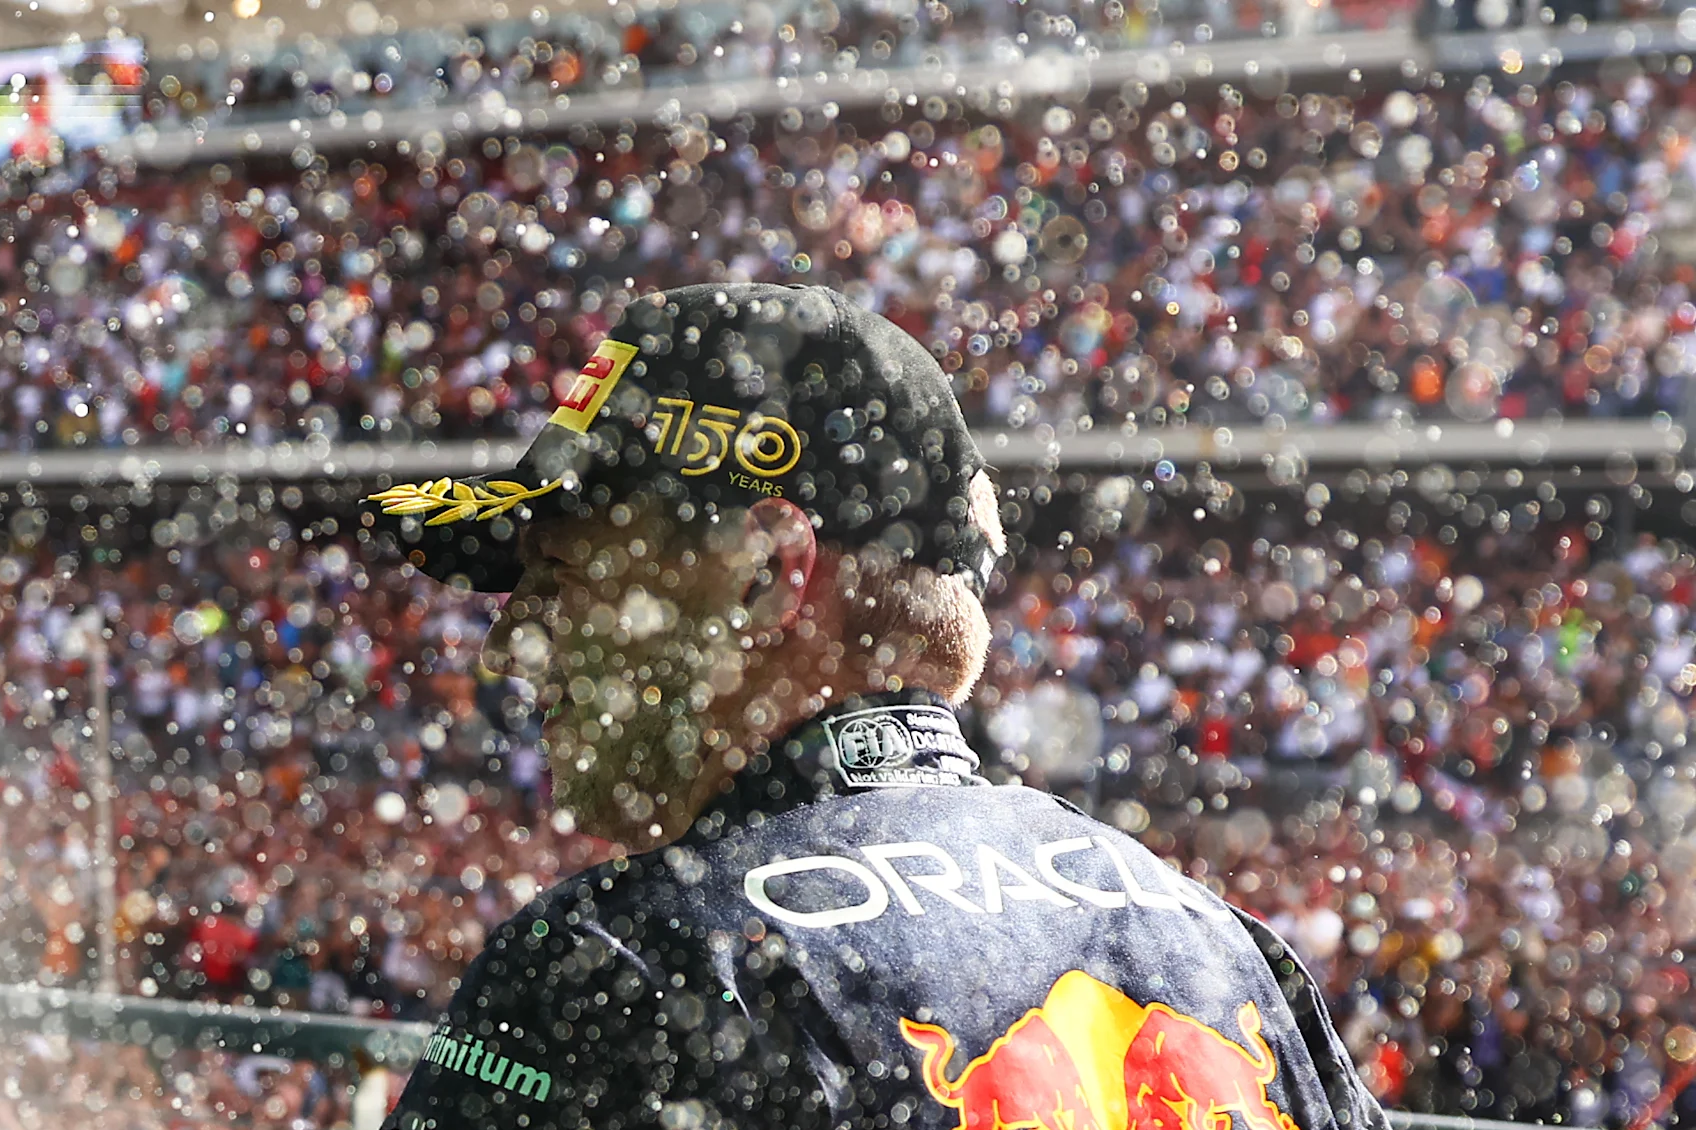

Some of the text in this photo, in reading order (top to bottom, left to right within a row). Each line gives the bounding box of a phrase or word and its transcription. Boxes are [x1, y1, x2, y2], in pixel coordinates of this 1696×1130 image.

[652, 397, 801, 477] 150
[728, 471, 784, 497] YEARS
[842, 725, 908, 764] FIA
[850, 772, 878, 783] Not
